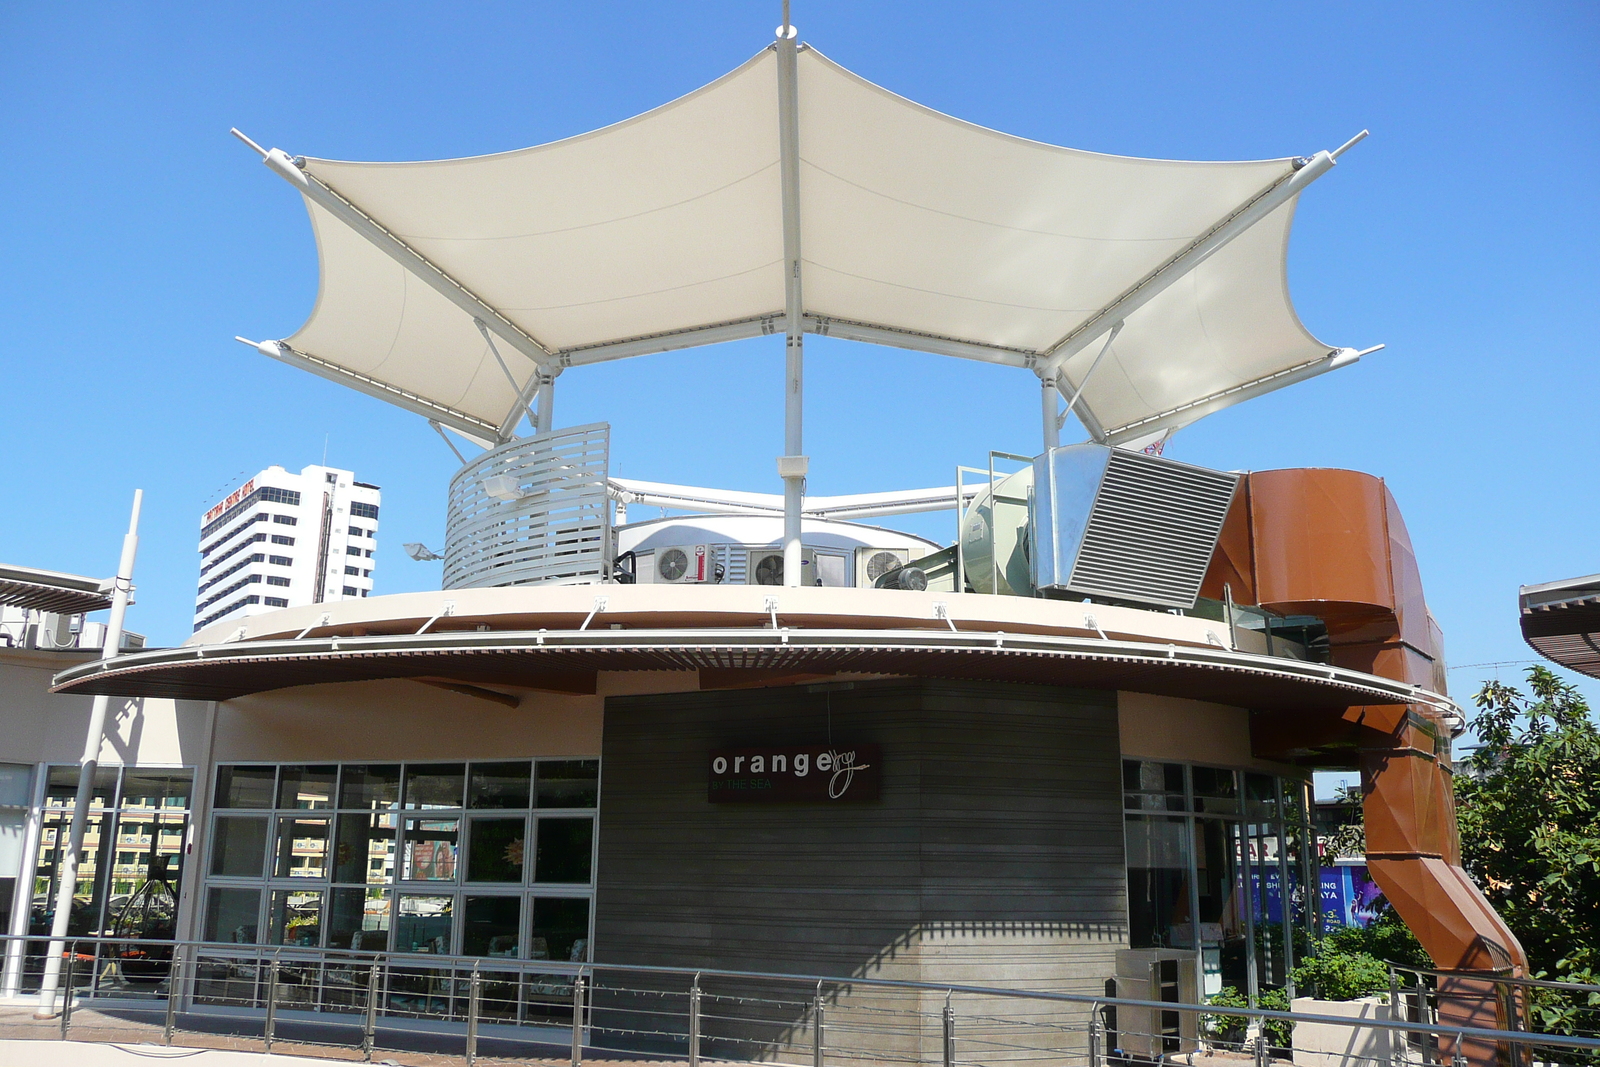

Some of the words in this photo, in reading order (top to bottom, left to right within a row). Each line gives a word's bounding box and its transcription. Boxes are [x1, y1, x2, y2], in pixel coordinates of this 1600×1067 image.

[712, 781, 724, 790] BY
[726, 779, 747, 790] THE
[750, 778, 772, 789] SEA
